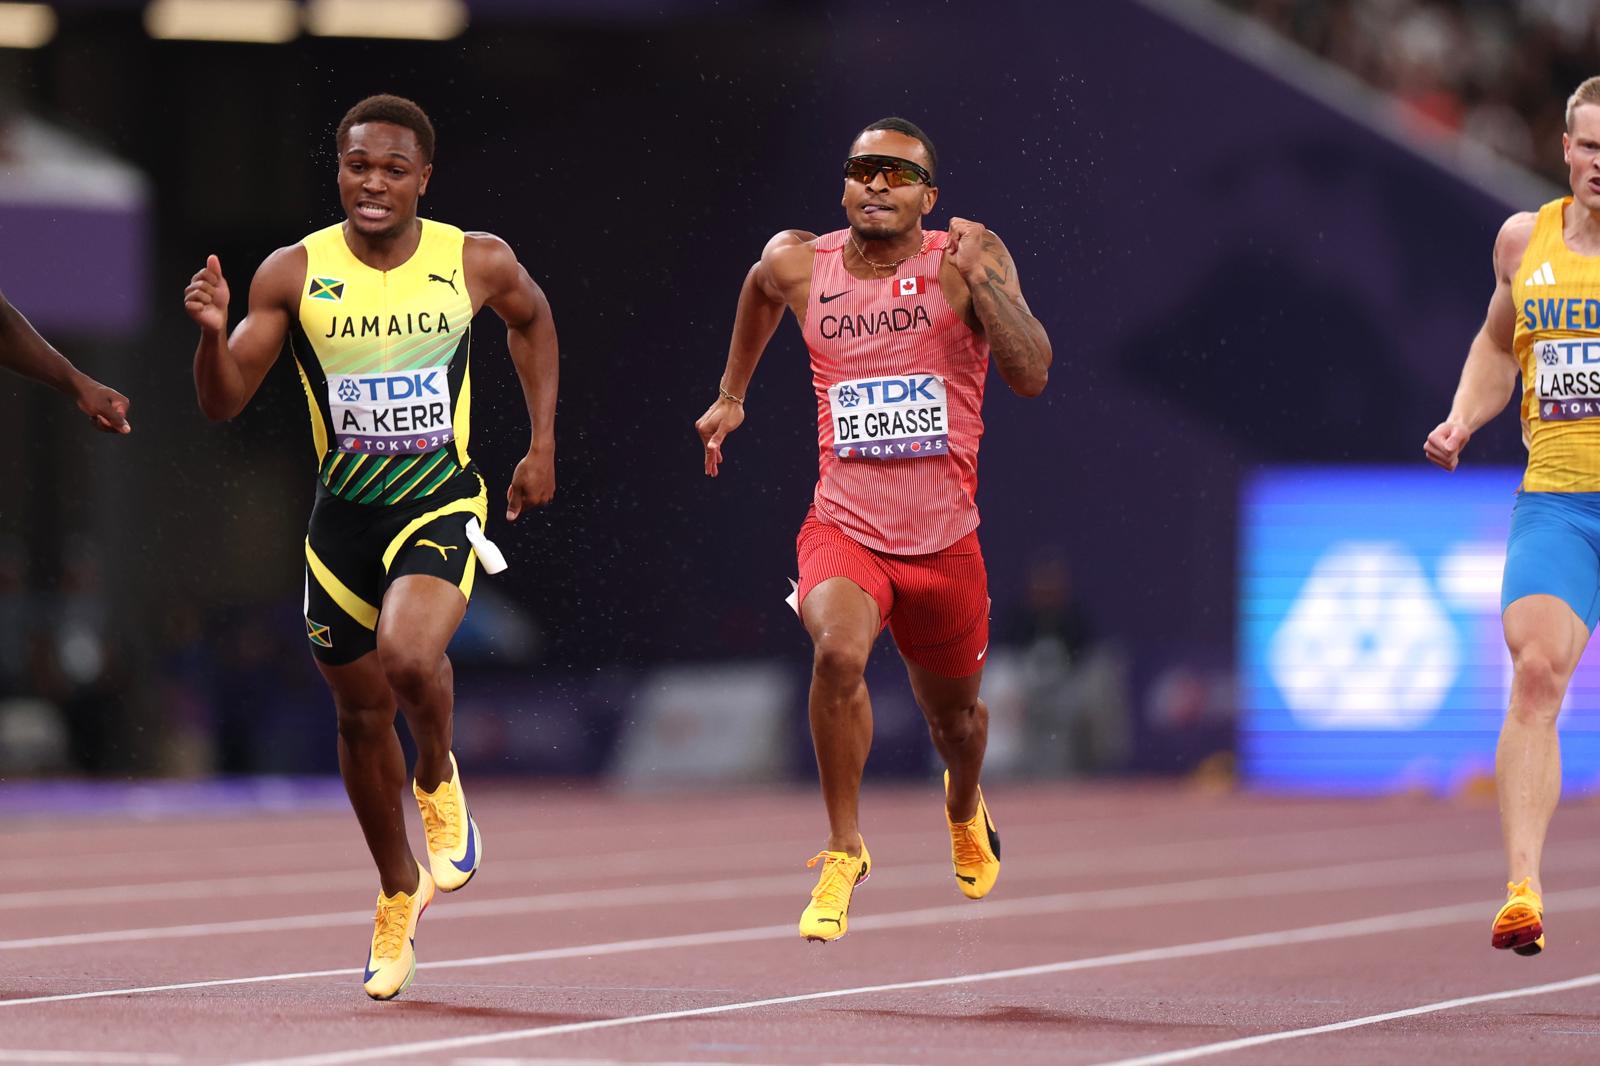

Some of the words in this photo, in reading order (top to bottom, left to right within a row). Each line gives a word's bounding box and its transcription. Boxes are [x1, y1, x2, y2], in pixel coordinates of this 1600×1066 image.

[325, 311, 451, 338] JAMAICA
[819, 305, 932, 340] CANADA
[1524, 298, 1600, 330] SWED
[359, 371, 440, 401] TDK
[857, 377, 937, 405] TDK
[1540, 371, 1600, 397] LARSS
[341, 409, 366, 432] A.
[372, 402, 445, 432] KERR
[838, 414, 860, 441] DE
[864, 406, 944, 438] GRASSE
